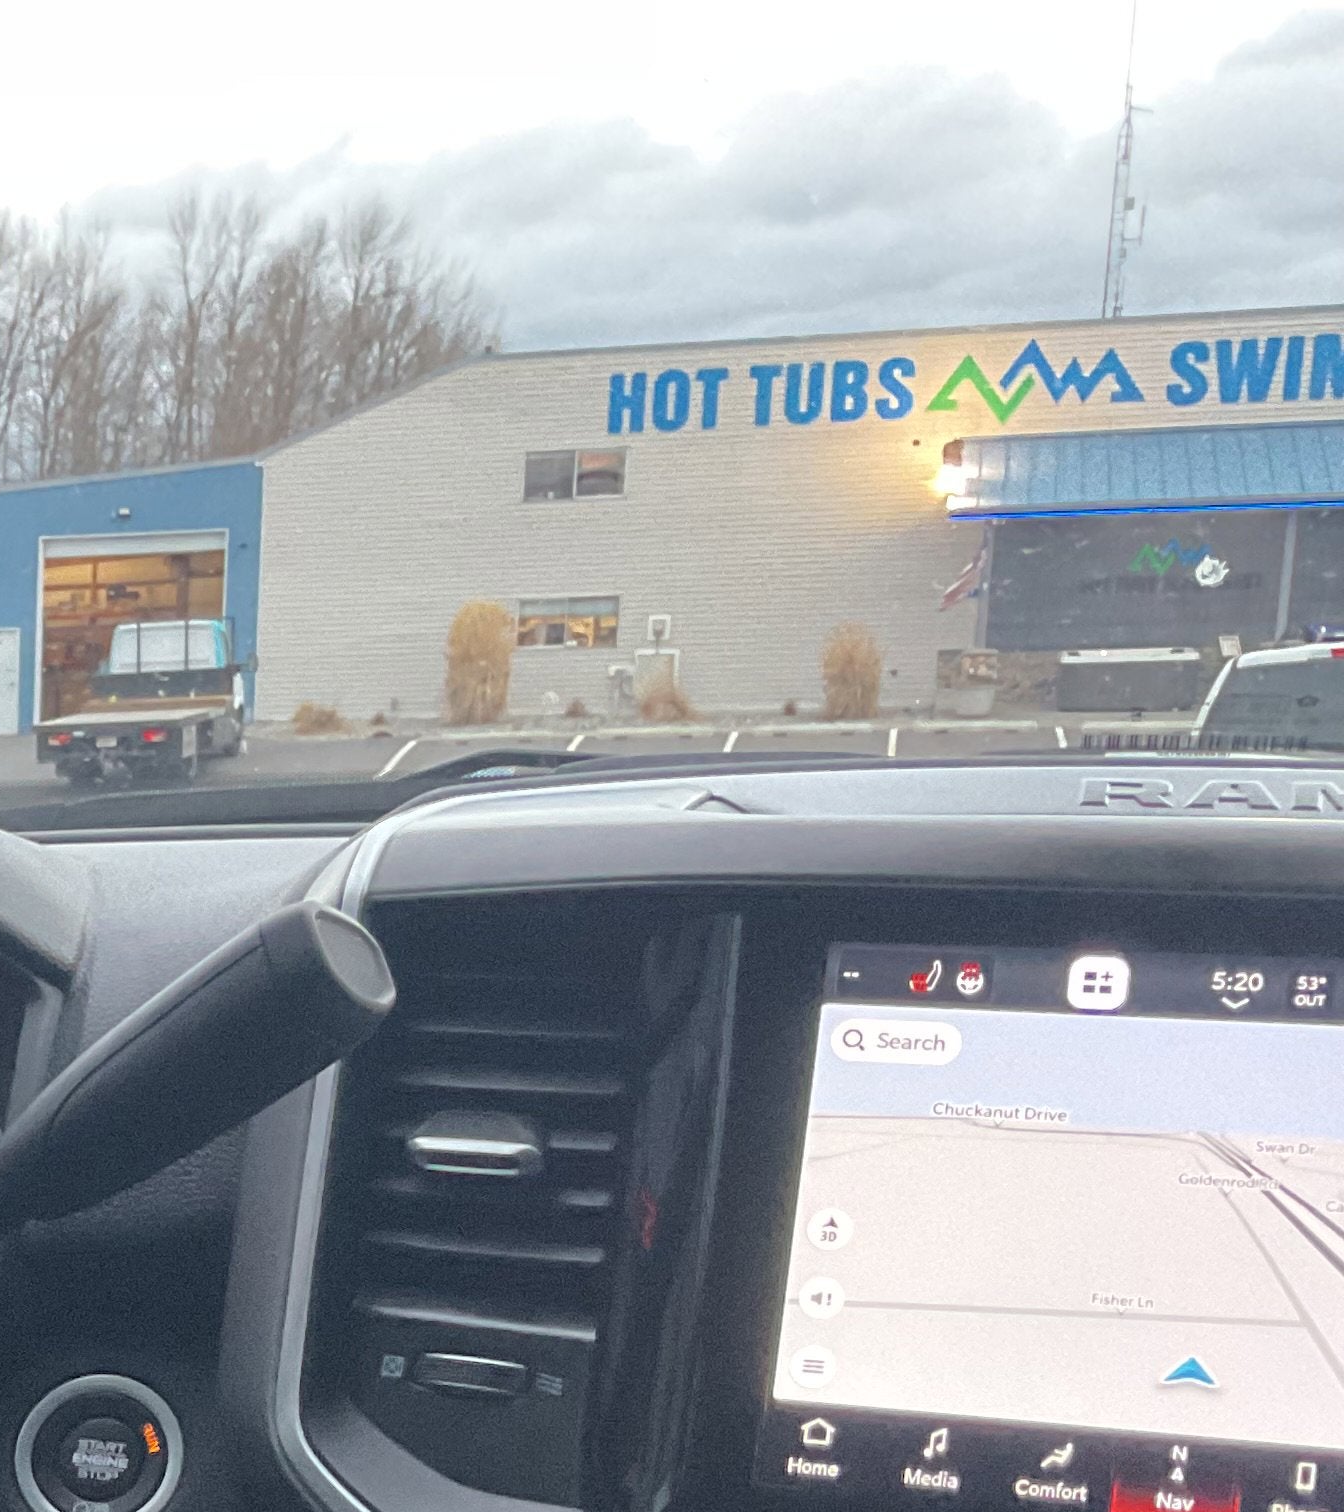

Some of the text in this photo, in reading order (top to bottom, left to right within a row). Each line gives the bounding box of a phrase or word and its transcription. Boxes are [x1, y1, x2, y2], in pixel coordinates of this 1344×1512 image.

[607, 357, 916, 433] HOT TUBS
[1211, 971, 1264, 992] 5:20
[1294, 993, 1327, 1007] OUT
[876, 1032, 946, 1052] Search
[932, 1101, 1068, 1123] Chuckanut Drive
[1255, 1140, 1316, 1155] Swan Dr
[1178, 1172, 1257, 1189] Goldenrod
[819, 1230, 837, 1242] 3D
[1091, 1292, 1154, 1308] Fisher Ln
[787, 1456, 840, 1478] Home
[903, 1467, 959, 1491] Media
[1014, 1478, 1088, 1503] Comfort
[1155, 1491, 1195, 1512] Nav
